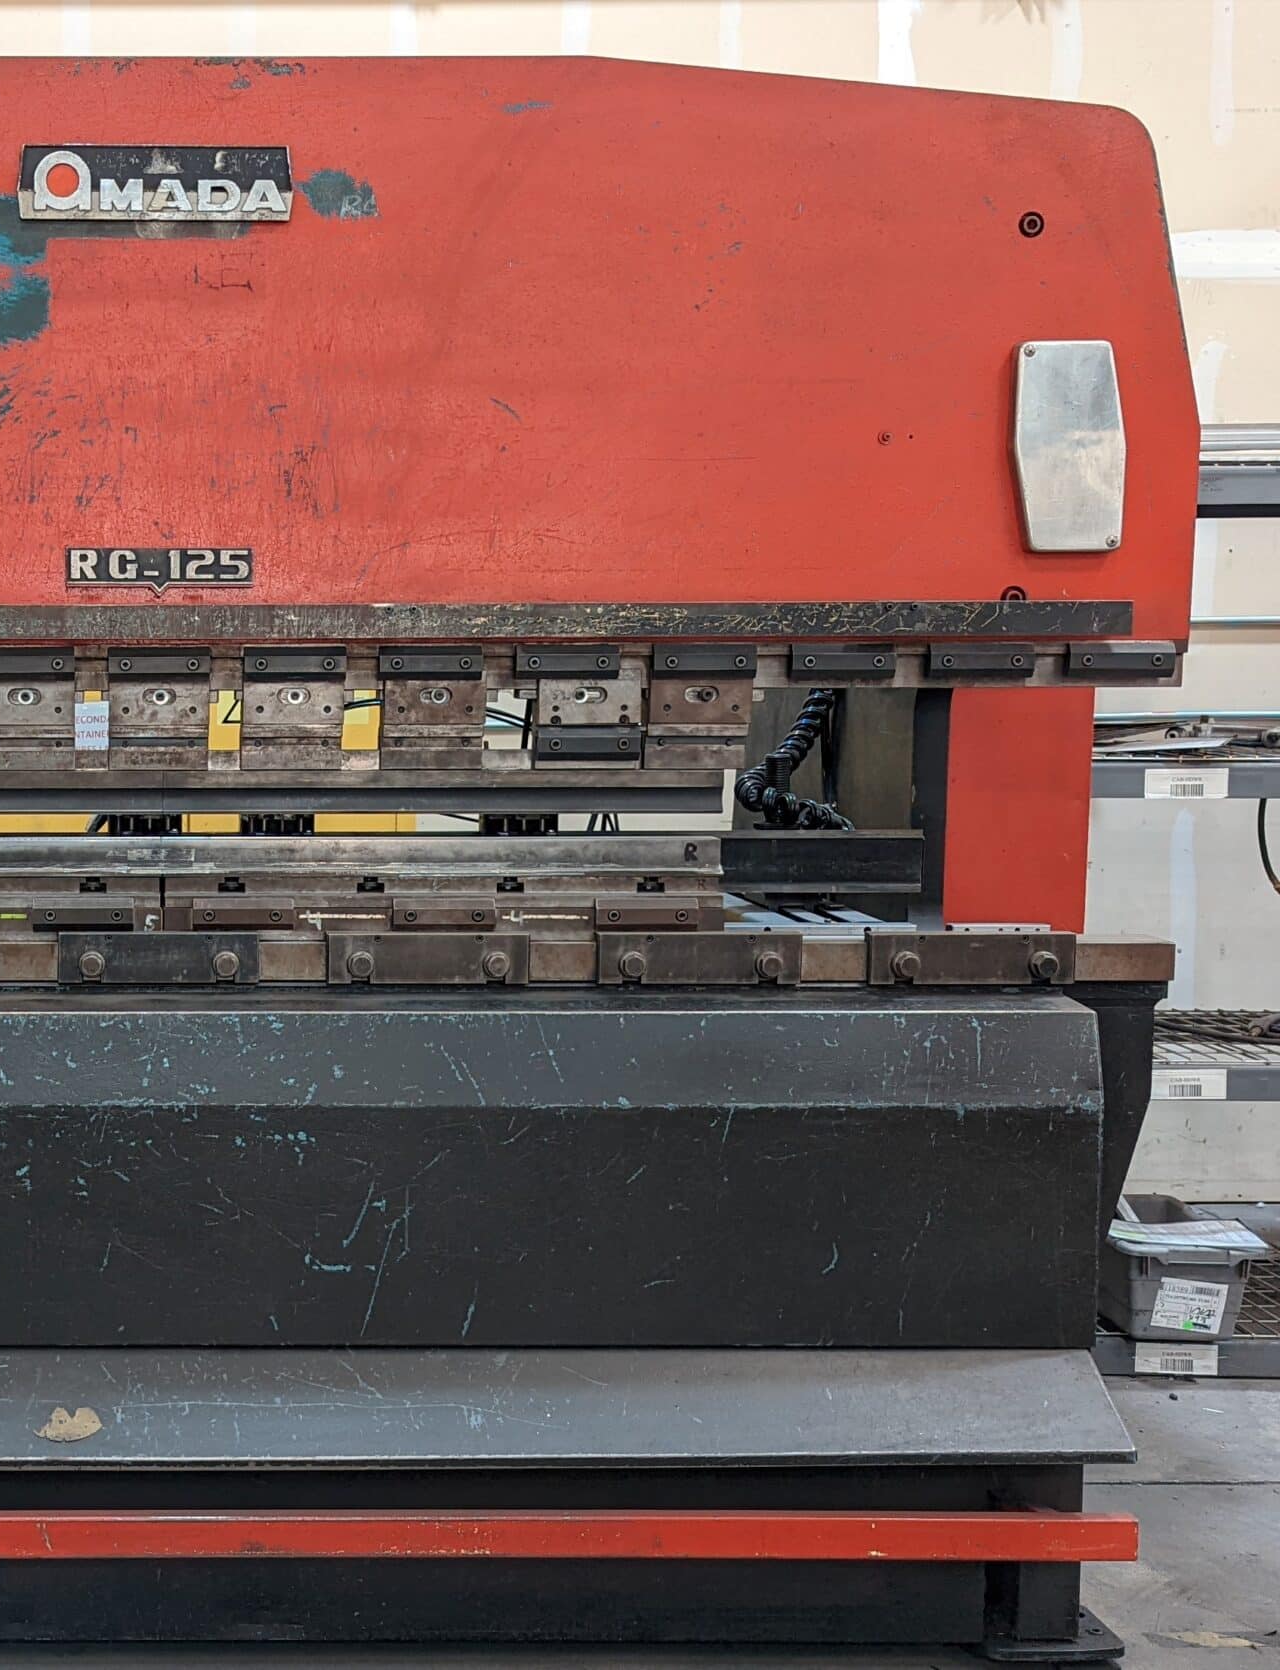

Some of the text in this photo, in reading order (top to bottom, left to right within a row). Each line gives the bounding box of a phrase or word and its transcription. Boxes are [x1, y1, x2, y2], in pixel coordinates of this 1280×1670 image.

[69, 549, 251, 579] RG-125
[76, 715, 108, 724] ECOND
[684, 842, 698, 861] R
